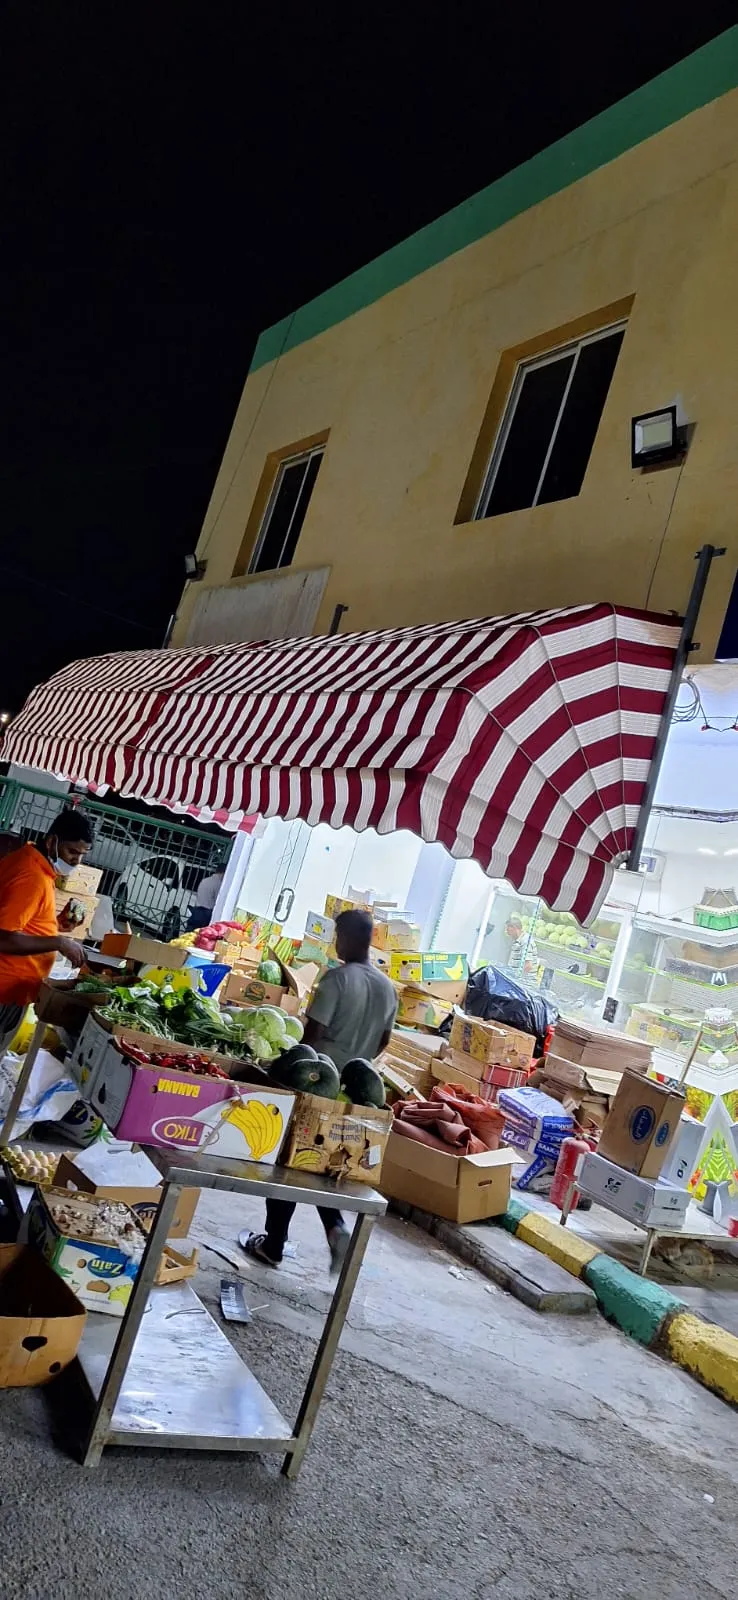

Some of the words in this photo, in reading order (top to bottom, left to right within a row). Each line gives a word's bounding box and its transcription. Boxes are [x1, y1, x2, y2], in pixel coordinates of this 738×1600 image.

[158, 1078, 200, 1098] BANANA
[163, 1122, 198, 1143] TIKO
[91, 1258, 124, 1275] Zain
